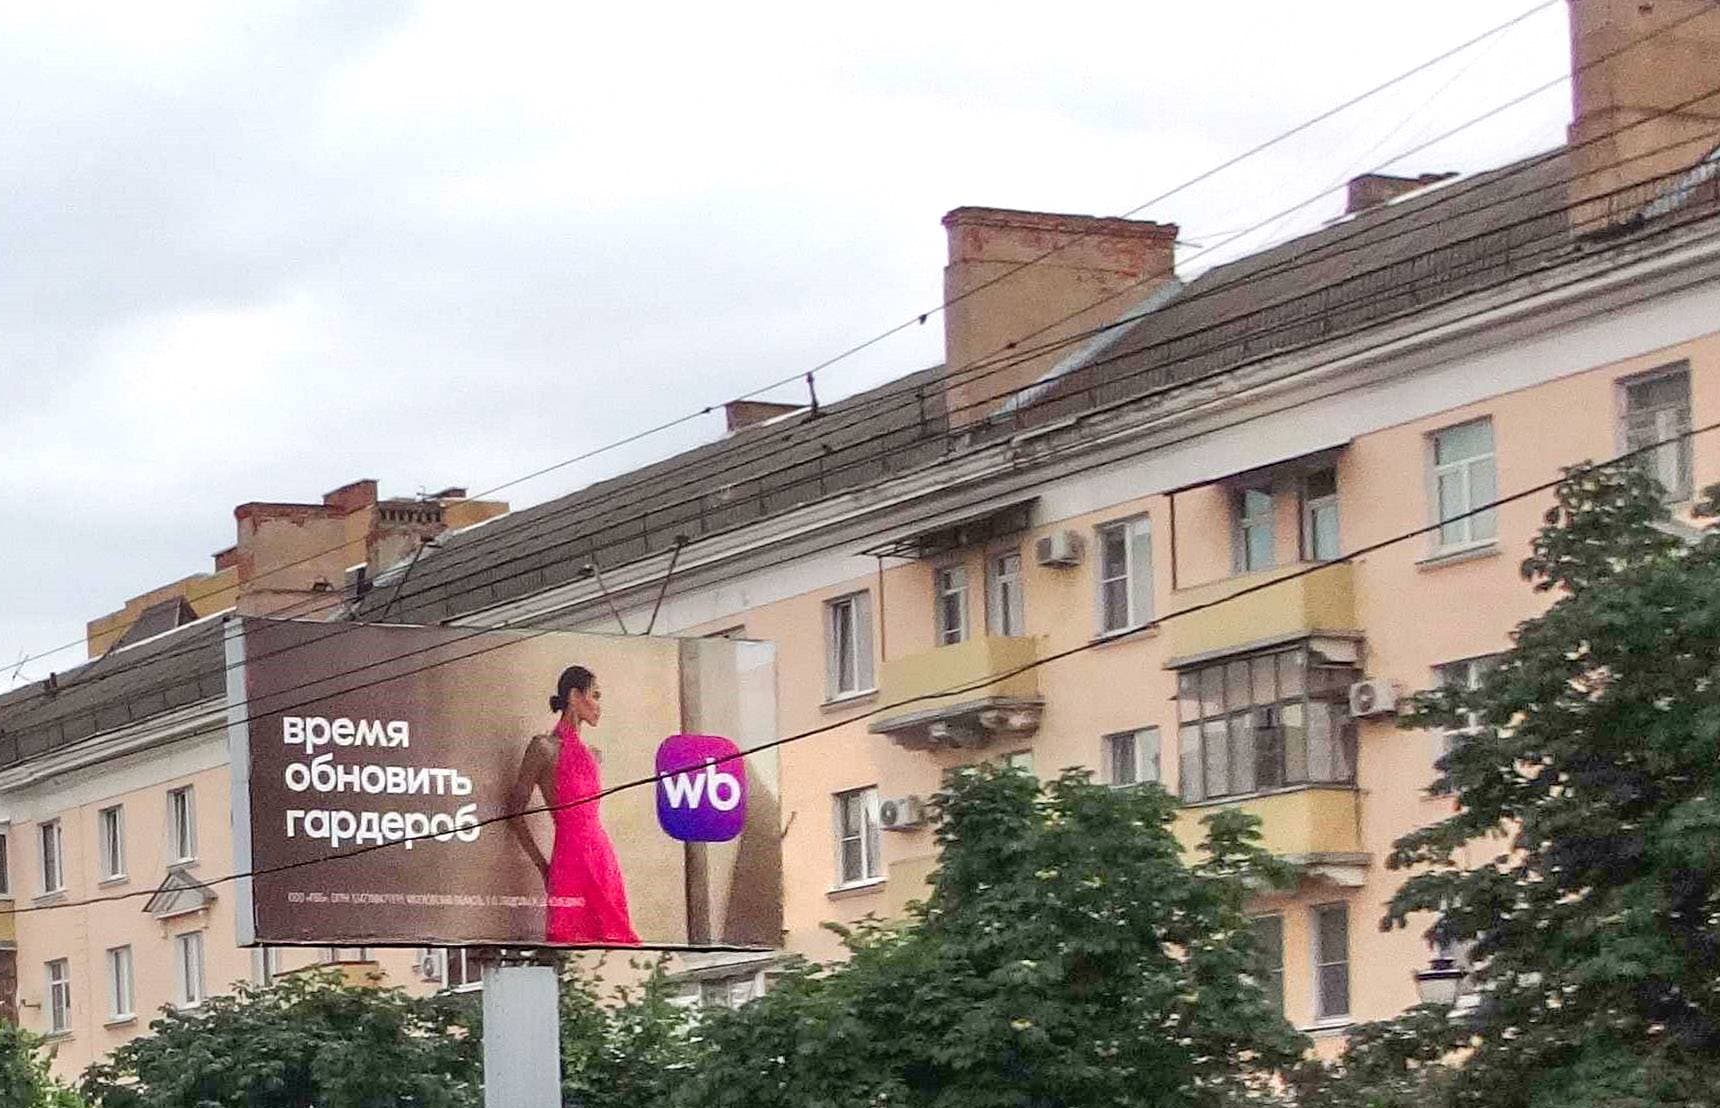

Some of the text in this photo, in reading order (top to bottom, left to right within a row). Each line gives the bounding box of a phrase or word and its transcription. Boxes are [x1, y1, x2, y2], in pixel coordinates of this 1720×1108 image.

[282, 716, 410, 754] время
[284, 752, 474, 796] обновить
[660, 756, 741, 812] wb
[285, 803, 481, 850] гардероб
